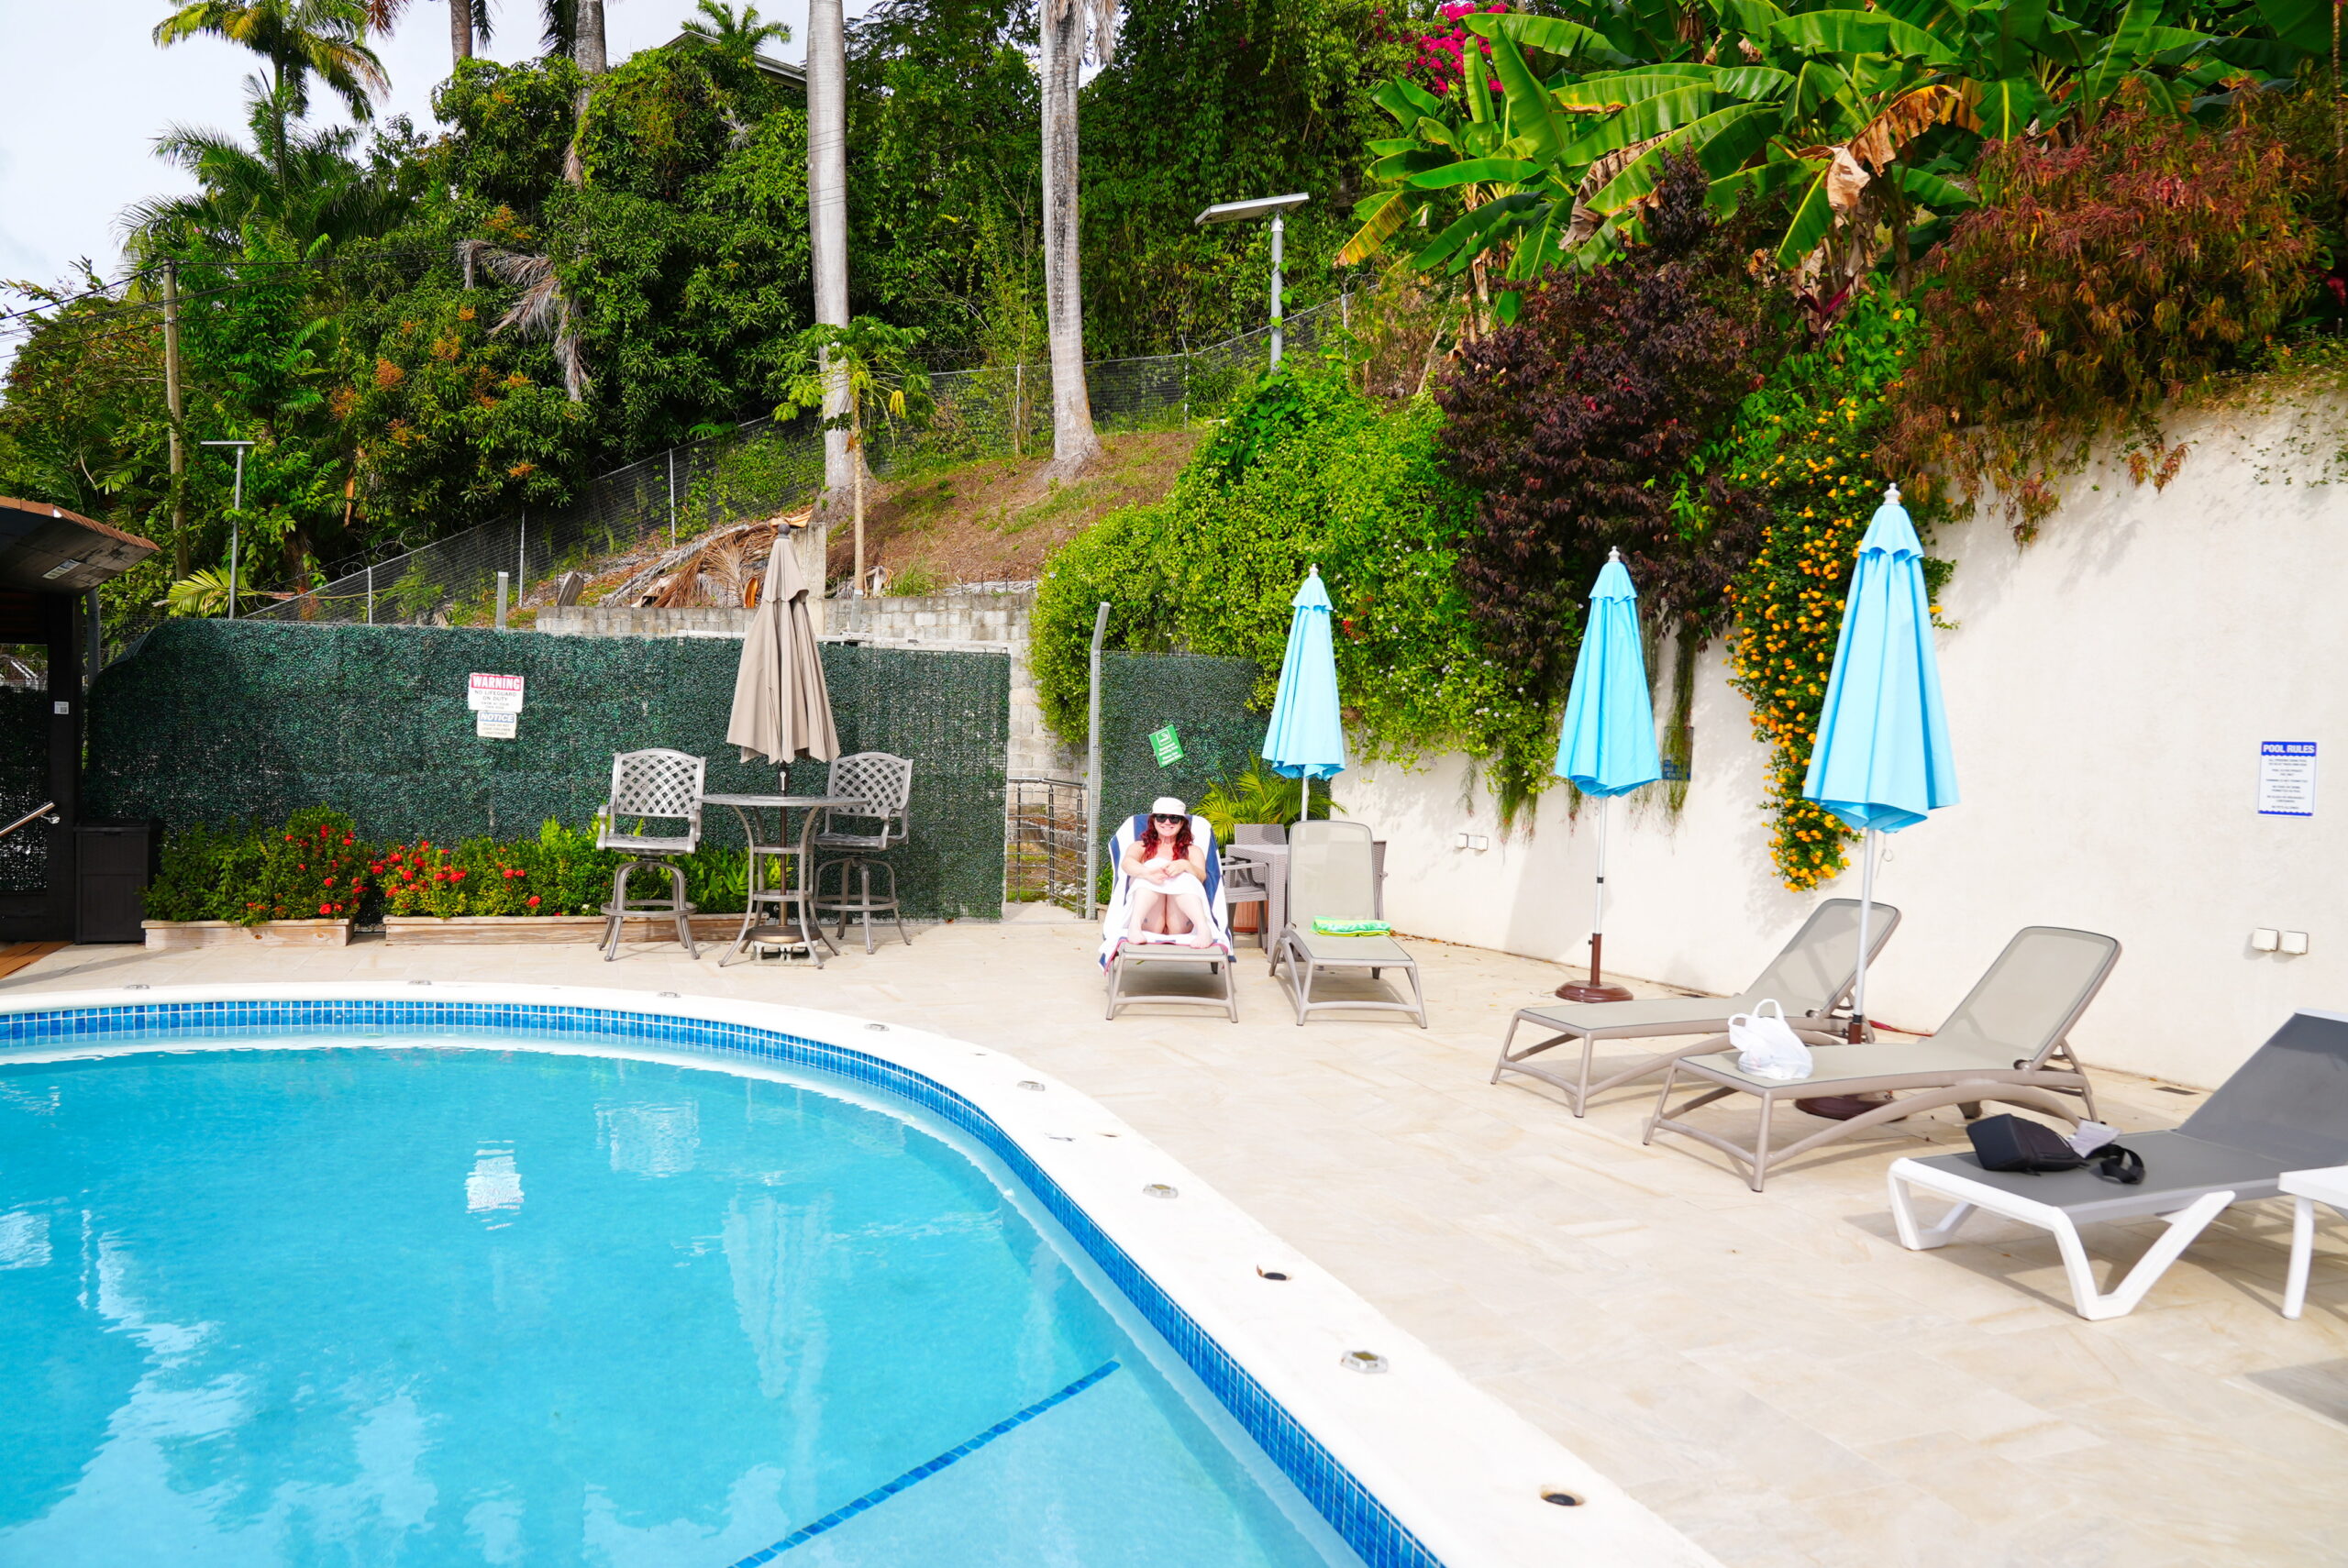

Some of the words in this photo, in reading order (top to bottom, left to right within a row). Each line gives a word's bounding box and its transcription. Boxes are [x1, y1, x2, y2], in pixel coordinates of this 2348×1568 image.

[472, 676, 520, 690] WARNING
[480, 712, 515, 723] NOTICE
[2263, 744, 2286, 753] POOL
[2287, 745, 2315, 754] RULES
